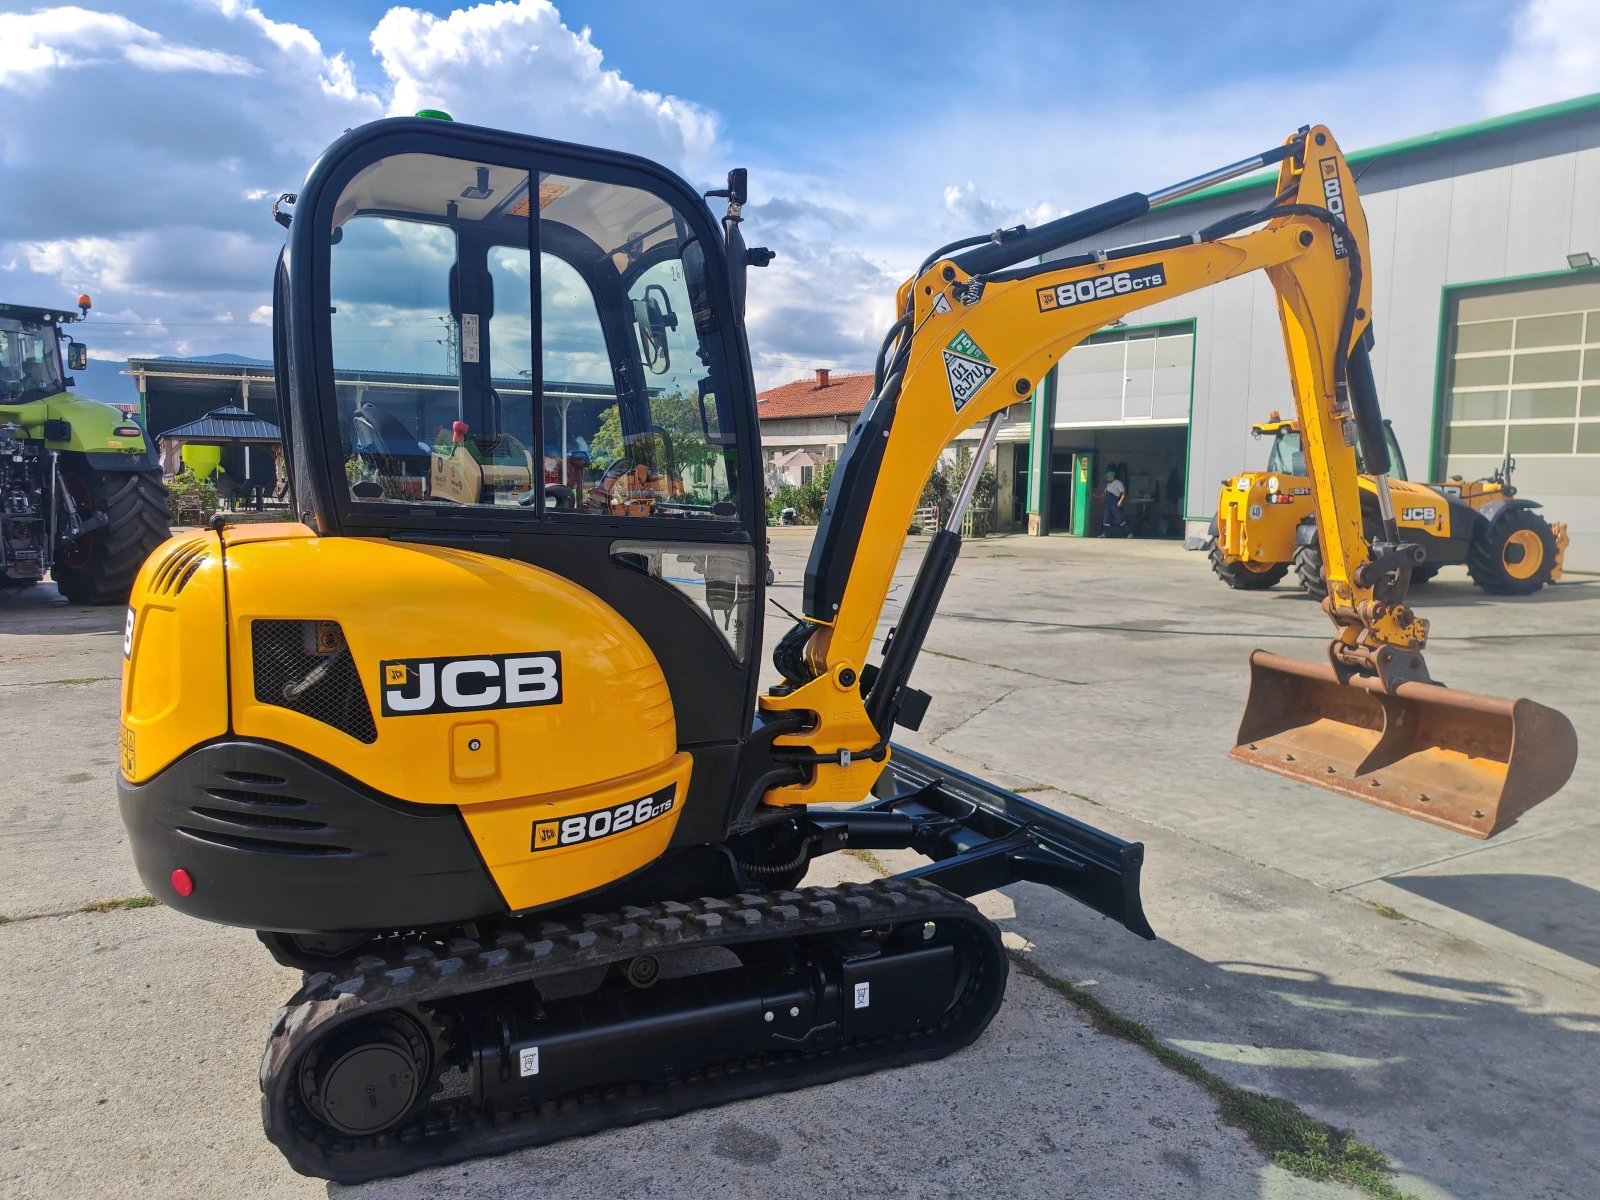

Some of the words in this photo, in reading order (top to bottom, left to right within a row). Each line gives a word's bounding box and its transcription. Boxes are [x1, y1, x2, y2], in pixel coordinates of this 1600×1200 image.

[961, 337, 972, 348] 5
[954, 365, 983, 397] BJ7U
[1251, 507, 1260, 517] 40
[1402, 508, 1435, 520] JCB
[387, 656, 559, 711] JCB
[541, 828, 555, 842] JCB
